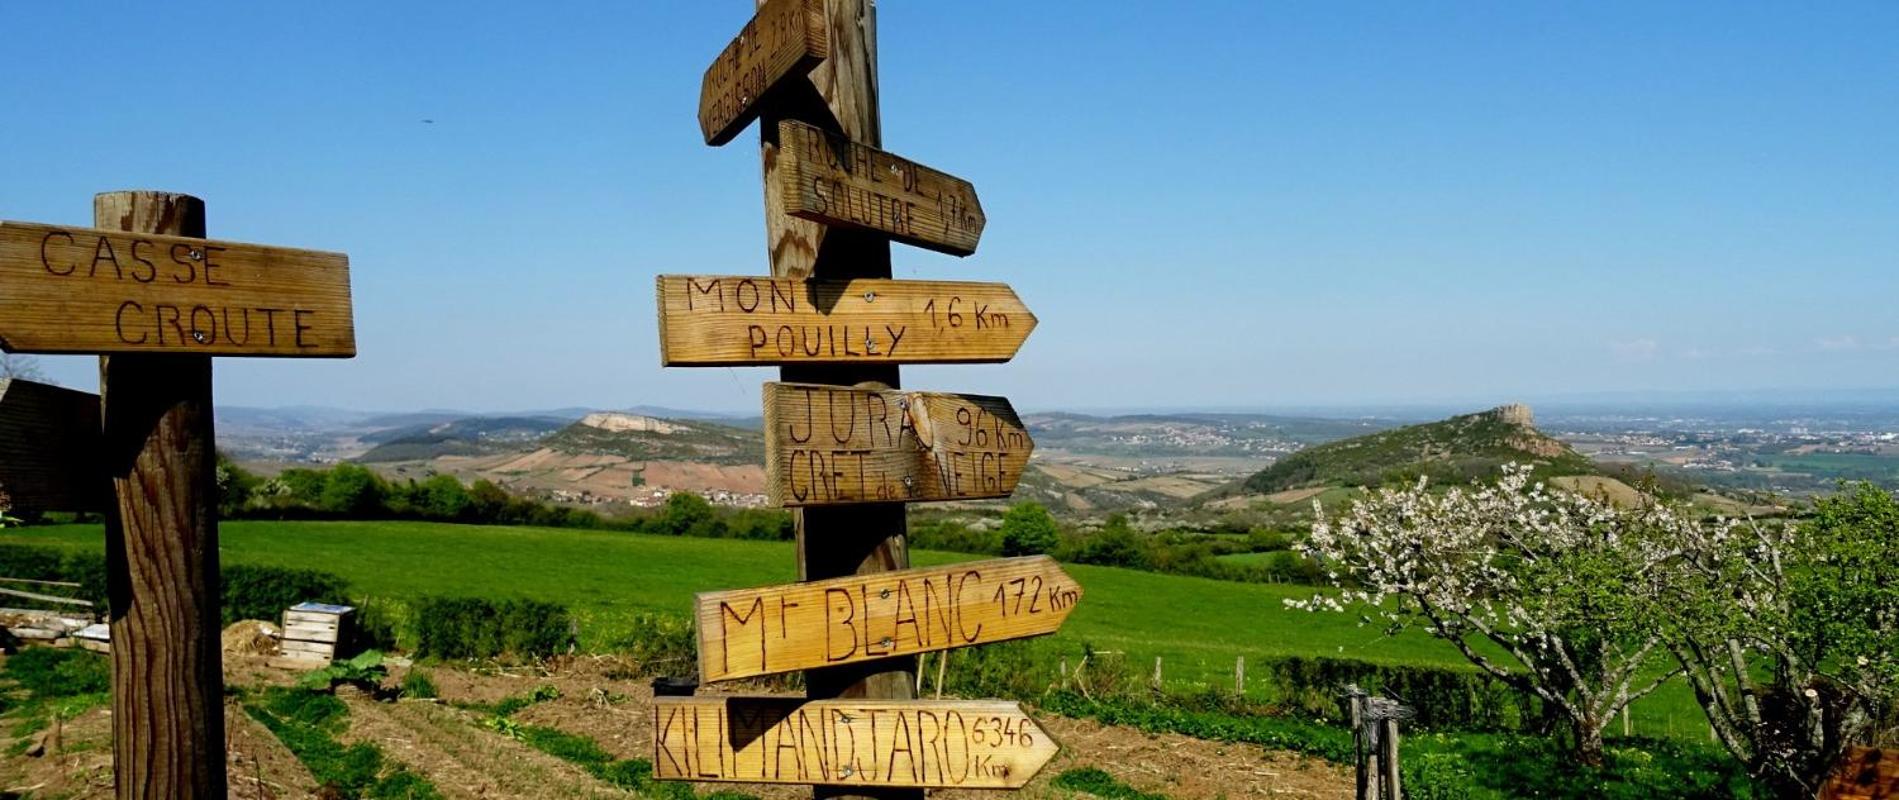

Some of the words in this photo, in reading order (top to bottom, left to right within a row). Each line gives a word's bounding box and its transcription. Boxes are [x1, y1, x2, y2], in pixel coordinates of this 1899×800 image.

[807, 129, 882, 183] ROCHE
[902, 161, 925, 197] DE
[813, 175, 919, 236] SOLUTRE
[40, 230, 231, 286] CASSE
[114, 300, 319, 349] CROUTE
[747, 324, 906, 359] POUILLY
[924, 296, 964, 336] 1,6
[789, 388, 931, 449] JURA
[956, 406, 987, 449] 96
[788, 448, 873, 502] CRET
[876, 470, 897, 500] de
[934, 450, 1011, 498] NEIGE
[825, 569, 982, 663] BLANC
[993, 574, 1043, 617] 172
[654, 704, 970, 785] KILIMANDJARO
[971, 717, 1034, 748] 6346
[974, 753, 1010, 780] Km
